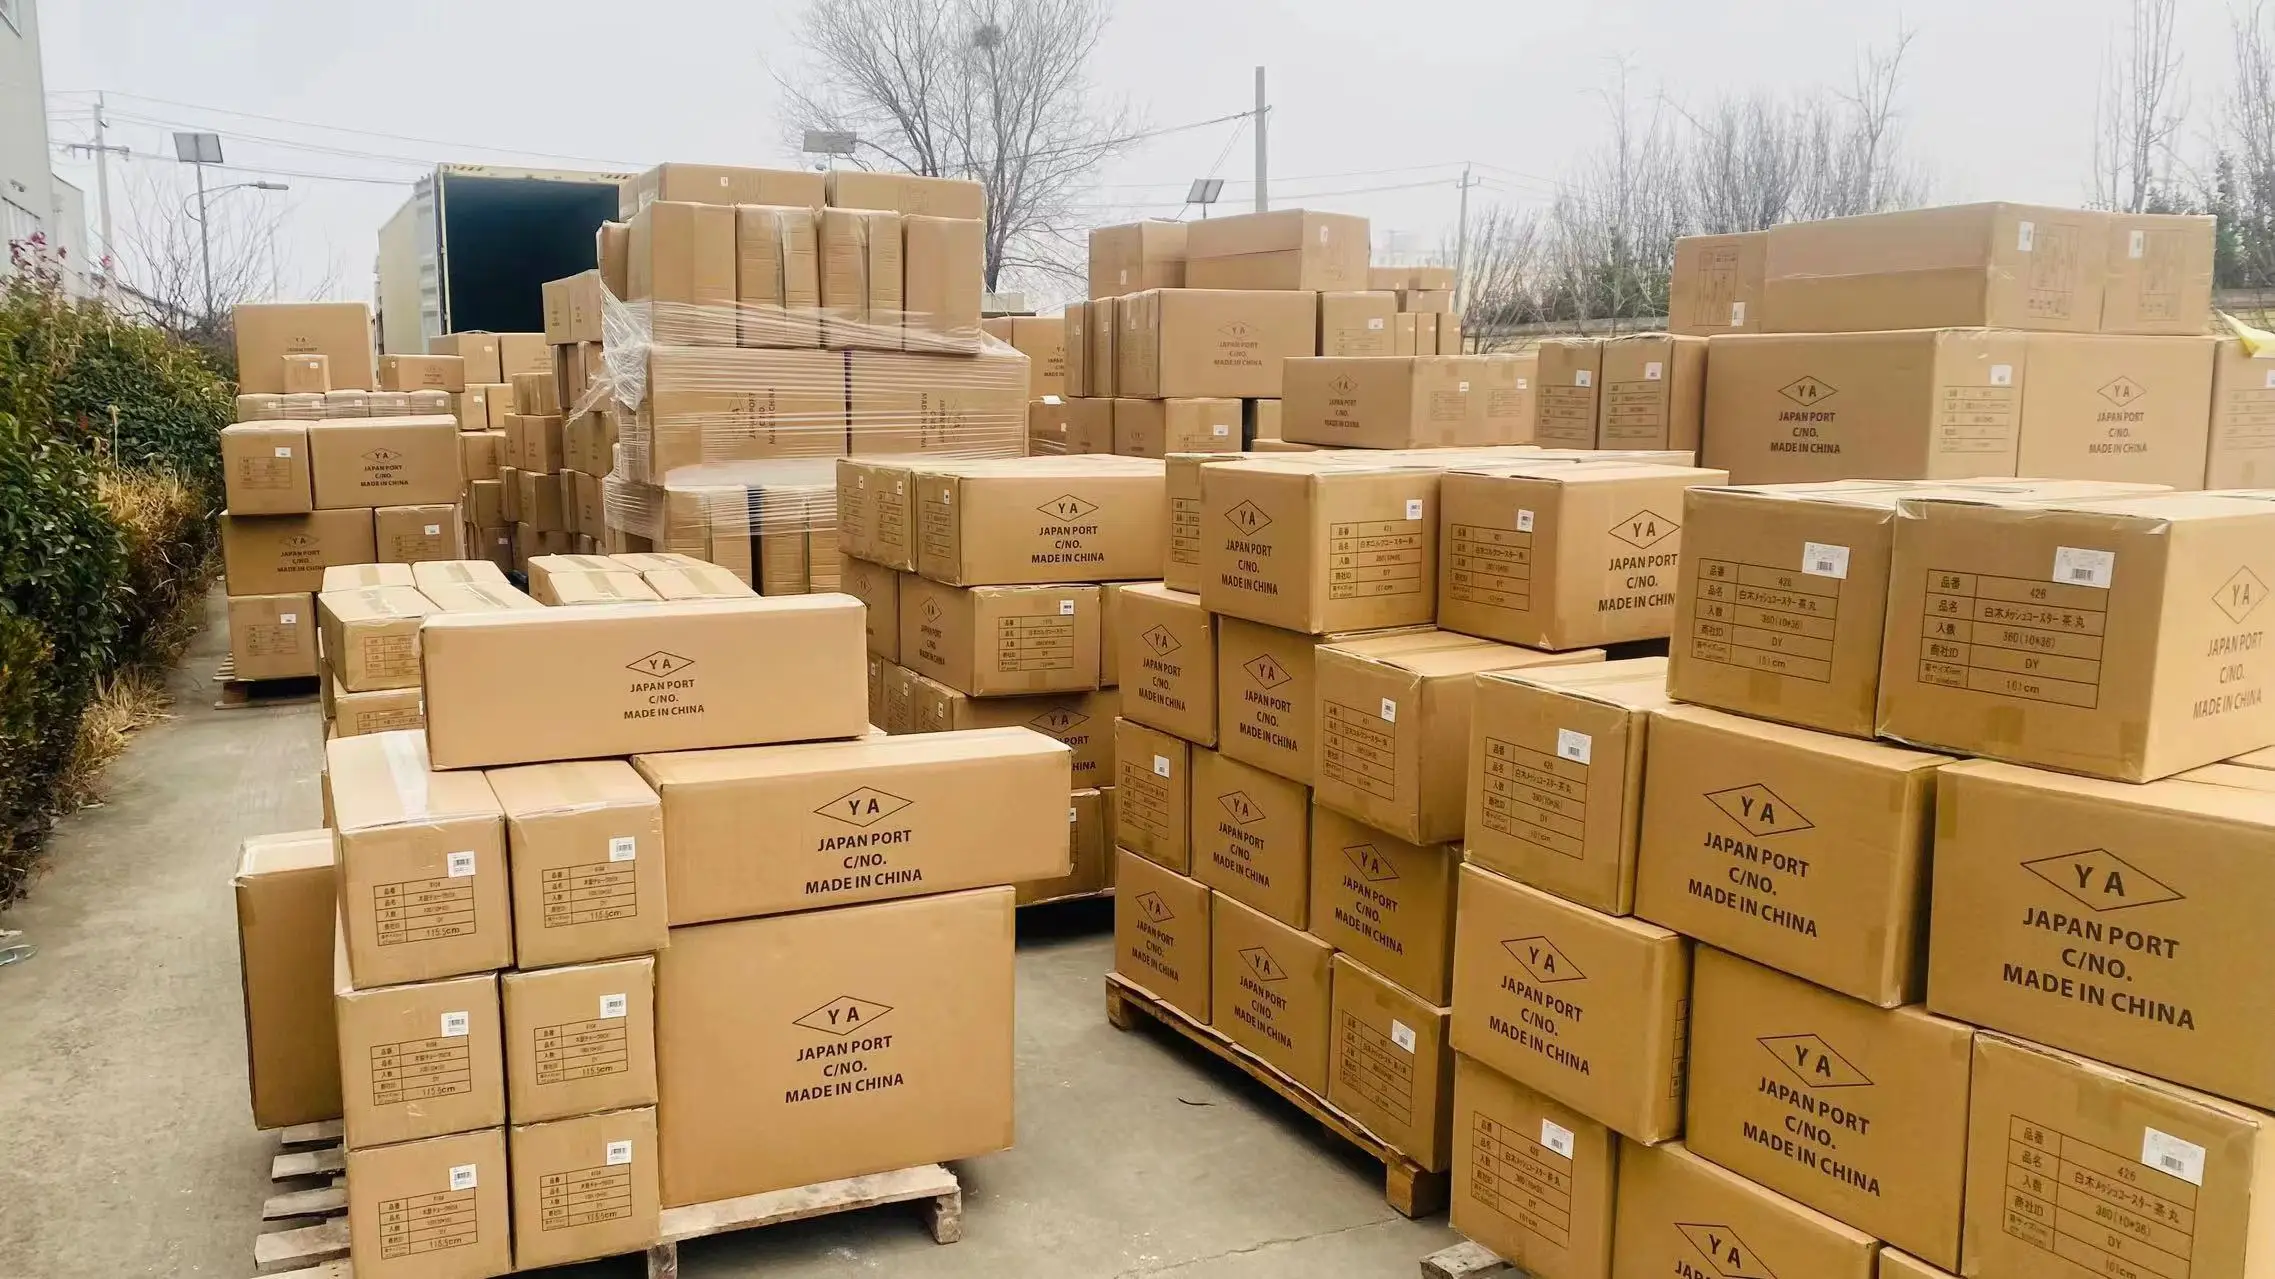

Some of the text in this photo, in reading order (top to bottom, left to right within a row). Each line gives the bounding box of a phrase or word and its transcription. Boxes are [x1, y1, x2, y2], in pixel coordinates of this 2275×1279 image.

[1778, 411, 1836, 425] JAPAN PORT
[2096, 410, 2144, 424] JAPAN PORT
[1792, 423, 1818, 441] C/NO.
[1770, 439, 1840, 456] MADE IN CHINA
[2088, 440, 2147, 456] MADE IN CHINA
[1039, 525, 1098, 535] JAPAN PORT
[1054, 539, 1081, 549] C/NO.
[1225, 538, 1272, 557] JAPAN PORT
[1031, 552, 1104, 563] MADE IN CHINA
[1237, 559, 1259, 575] C/NO.
[1608, 553, 1678, 571] JAPAN PORT
[1221, 573, 1278, 597] MADE IN CHINA
[1626, 574, 1658, 589] C/NO.
[1597, 592, 1676, 611] MADE IN CHIN
[1938, 599, 1959, 614] 品名
[2207, 630, 2263, 657] JAPAN PORT
[1142, 657, 1182, 676] JAPAN PORT
[2025, 658, 2040, 671] DY
[629, 678, 694, 692] JAPAN PORT
[1152, 673, 1170, 692] C/NO.
[648, 693, 678, 704] C/NO.
[1138, 687, 1185, 712] MADE IN CHINA
[1244, 689, 1291, 713] JAPAN PORT
[2192, 687, 2262, 718] MADE IN CHINA
[623, 704, 704, 719] MADE IN CHINA
[1256, 710, 1278, 727] C/NO.
[1239, 722, 1297, 751] MADE IN CHINA
[817, 829, 911, 851] JAPAN PORT
[1218, 821, 1264, 850] JAPAN PORT
[843, 853, 886, 869] C/NO.
[1229, 843, 1251, 863] C/NO.
[1703, 831, 1809, 877] JAPAN PORT
[1213, 851, 1271, 888] MADE IN CHINA
[805, 868, 922, 894] MADE IN CHINA
[1728, 866, 1776, 896] C/NO.
[1343, 874, 1398, 912] JAPAN PORT
[1355, 901, 1381, 923] C/NO.
[1688, 878, 1817, 937] MADE IN CHINA
[1136, 919, 1174, 947] JAPAN PORT
[1335, 906, 1402, 955] MADE IN CHINA
[2023, 908, 2180, 959] JAPAN PORT
[1131, 946, 1178, 984] MADE IN CHINA
[2062, 949, 2132, 982] C/NO.
[1239, 975, 1287, 1010] JAPAN PORT
[1500, 975, 1583, 1022] JAPAN PORT
[2003, 964, 2195, 1030] MADE IN CHINA
[1251, 999, 1273, 1020] C/NO.
[1234, 1005, 1292, 1049] MADE IN CHINA
[1520, 1007, 1558, 1036] C/NO.
[796, 1034, 892, 1061] JAPAN PORT
[1489, 1015, 1589, 1075] MADE IN CHINA
[823, 1060, 867, 1076] C/NO.
[785, 1072, 903, 1103] MADE IN CHINA
[1758, 1076, 1870, 1135] JAPAN PORT
[1784, 1115, 1835, 1149] C/NO.
[1743, 1121, 1880, 1197] MADE IN CHINA
[2022, 1150, 2043, 1169] 品名
[2022, 1174, 2043, 1194] 入数
[2117, 1166, 2137, 1182] 426
[2107, 1235, 2122, 1250] DY
